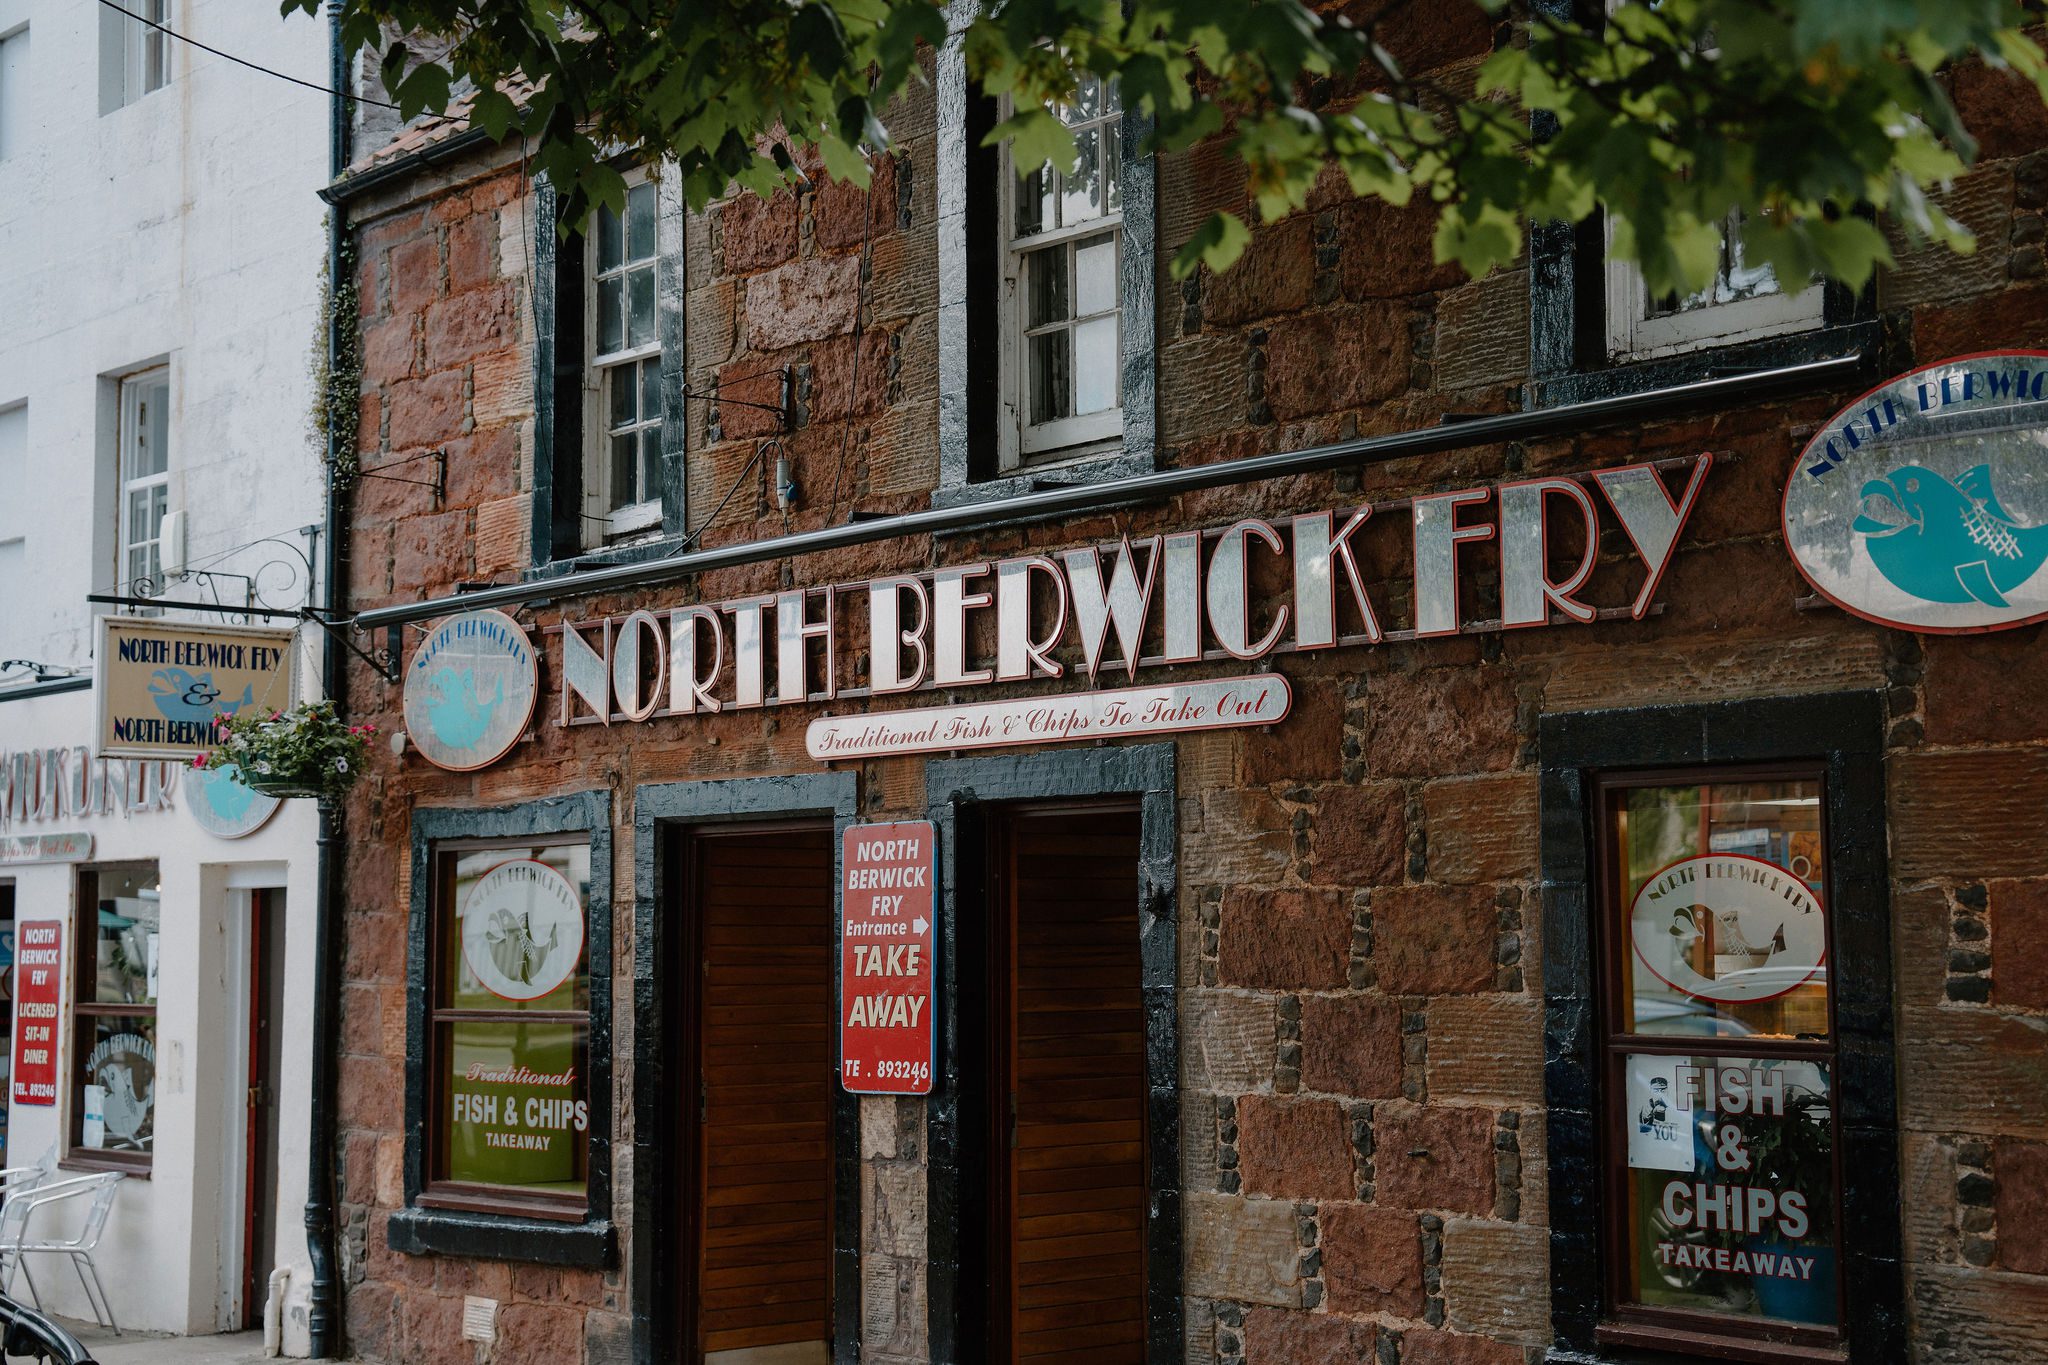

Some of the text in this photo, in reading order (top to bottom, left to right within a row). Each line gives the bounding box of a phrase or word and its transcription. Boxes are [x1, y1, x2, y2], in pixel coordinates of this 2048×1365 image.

[1807, 367, 2048, 485] NORTH BERWIC
[561, 451, 1713, 727] NORTH BERWICK FRY
[119, 637, 283, 672] NORTH BERWICK FRY
[182, 683, 221, 706] &
[114, 716, 230, 748] NORTH BERWIC
[819, 689, 1269, 752] Traditional Fish & Chips To Take Out
[857, 839, 920, 862] NORTH
[848, 866, 927, 890] BERWICK
[1647, 863, 1815, 915] NORTH BERWICK FRY
[871, 895, 903, 916] FRY
[25, 928, 55, 945] NORTH
[846, 920, 907, 937] Entrance
[21, 949, 57, 965] BERWICK
[854, 944, 921, 977] TAKE
[31, 970, 47, 986] FRY
[19, 1003, 57, 1018] LICENSED
[848, 995, 926, 1028] AWAY
[25, 1026, 49, 1042] SIT-IN
[24, 1049, 48, 1064] DINER
[465, 1061, 577, 1087] Traditional
[877, 1061, 928, 1079] 893246
[15, 1082, 28, 1097] TEL.
[30, 1082, 55, 1098] 893246
[1675, 1064, 1785, 1117] FISH
[453, 1093, 588, 1132] FISH & CHIPS
[485, 1131, 551, 1151] TAKEAWAY
[1654, 1124, 1679, 1141] YOU
[1716, 1124, 1751, 1171] &
[1662, 1180, 1810, 1238] CHIPS
[1658, 1242, 1815, 1280] TAKEAWAY
